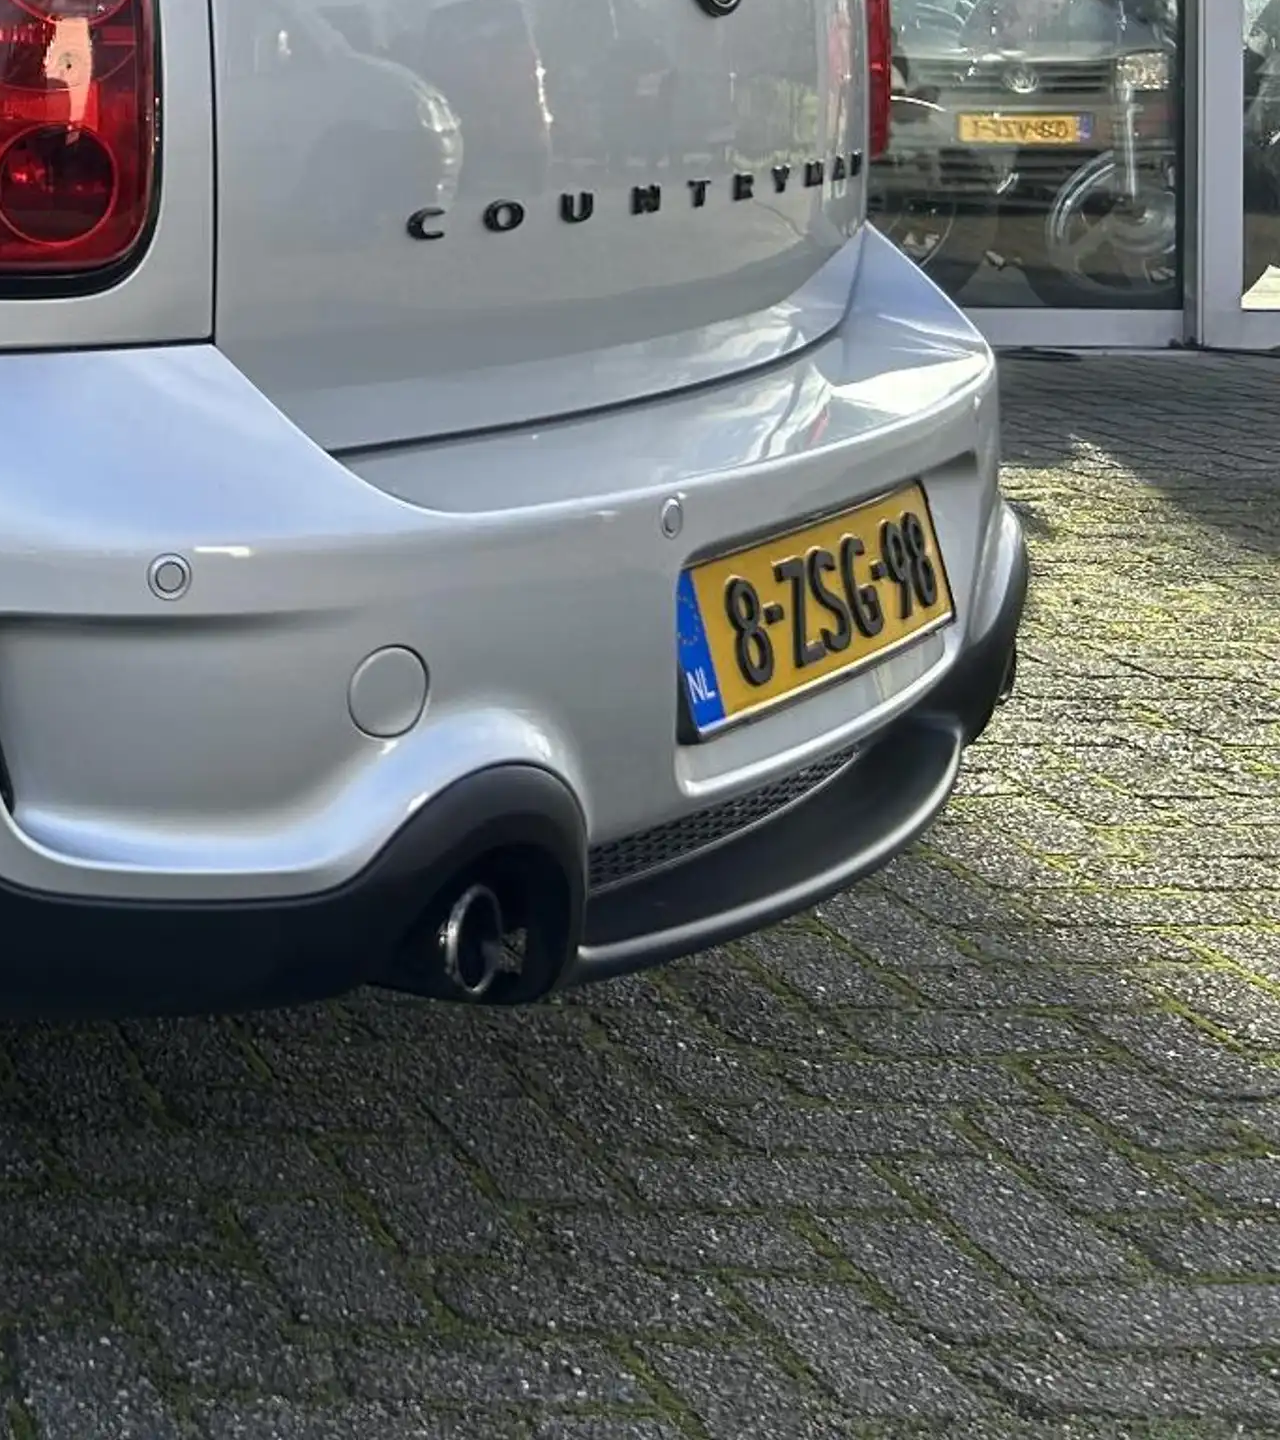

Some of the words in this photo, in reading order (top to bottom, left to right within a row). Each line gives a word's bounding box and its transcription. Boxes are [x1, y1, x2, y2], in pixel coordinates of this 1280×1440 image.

[406, 149, 863, 241] COUNTRYMAN
[724, 510, 939, 687] 8-ZSG-98
[686, 666, 717, 703] NL
